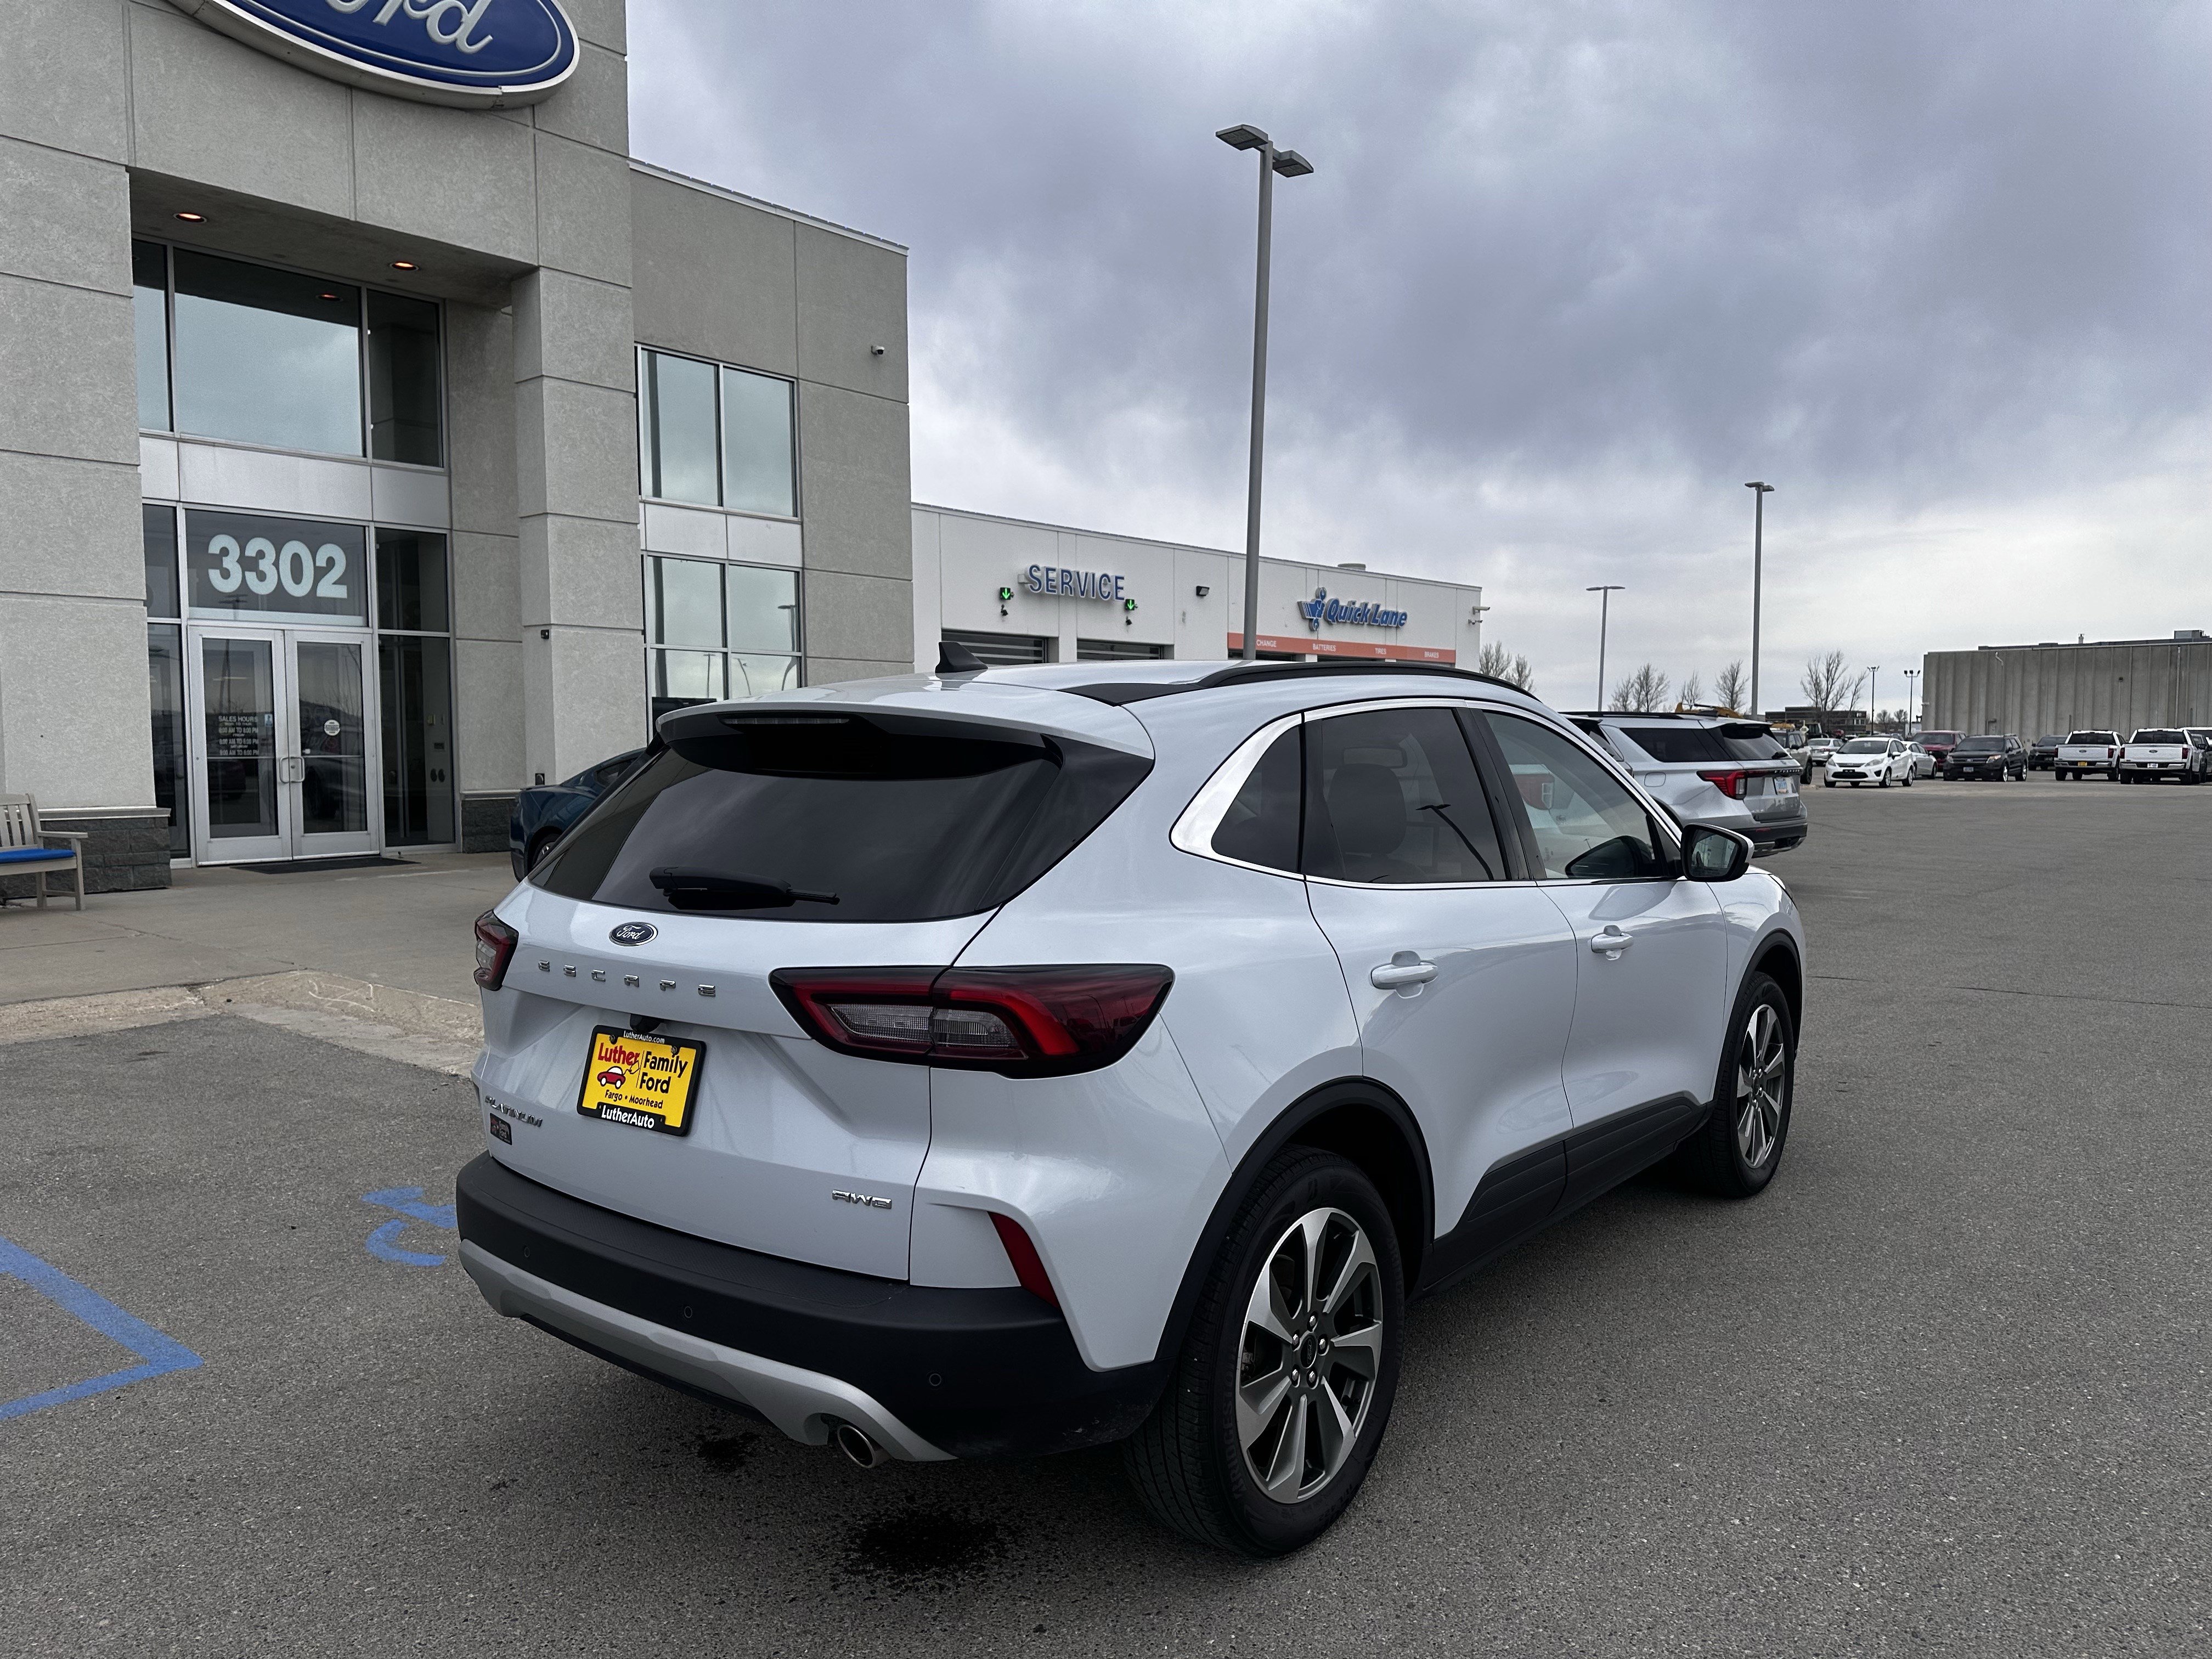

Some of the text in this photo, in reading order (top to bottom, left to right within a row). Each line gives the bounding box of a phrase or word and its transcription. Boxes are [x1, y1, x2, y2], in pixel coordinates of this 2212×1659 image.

[208, 534, 348, 599] 3302
[1028, 564, 1125, 601] SERVICE
[1326, 598, 1408, 627] Quick Lane
[1256, 639, 1277, 647] CHANGE
[1312, 644, 1336, 652] BATTERIES
[617, 925, 645, 940] Ford
[538, 960, 716, 997] ESCAPE
[623, 1030, 665, 1044] LutherAuto.com
[597, 1042, 640, 1066] Luther
[644, 1051, 689, 1078] Family
[639, 1071, 672, 1094] Ford
[605, 1089, 663, 1109] Fargo Moorhead
[601, 1104, 654, 1128] LutherAuto
[832, 1189, 892, 1209] AWD
